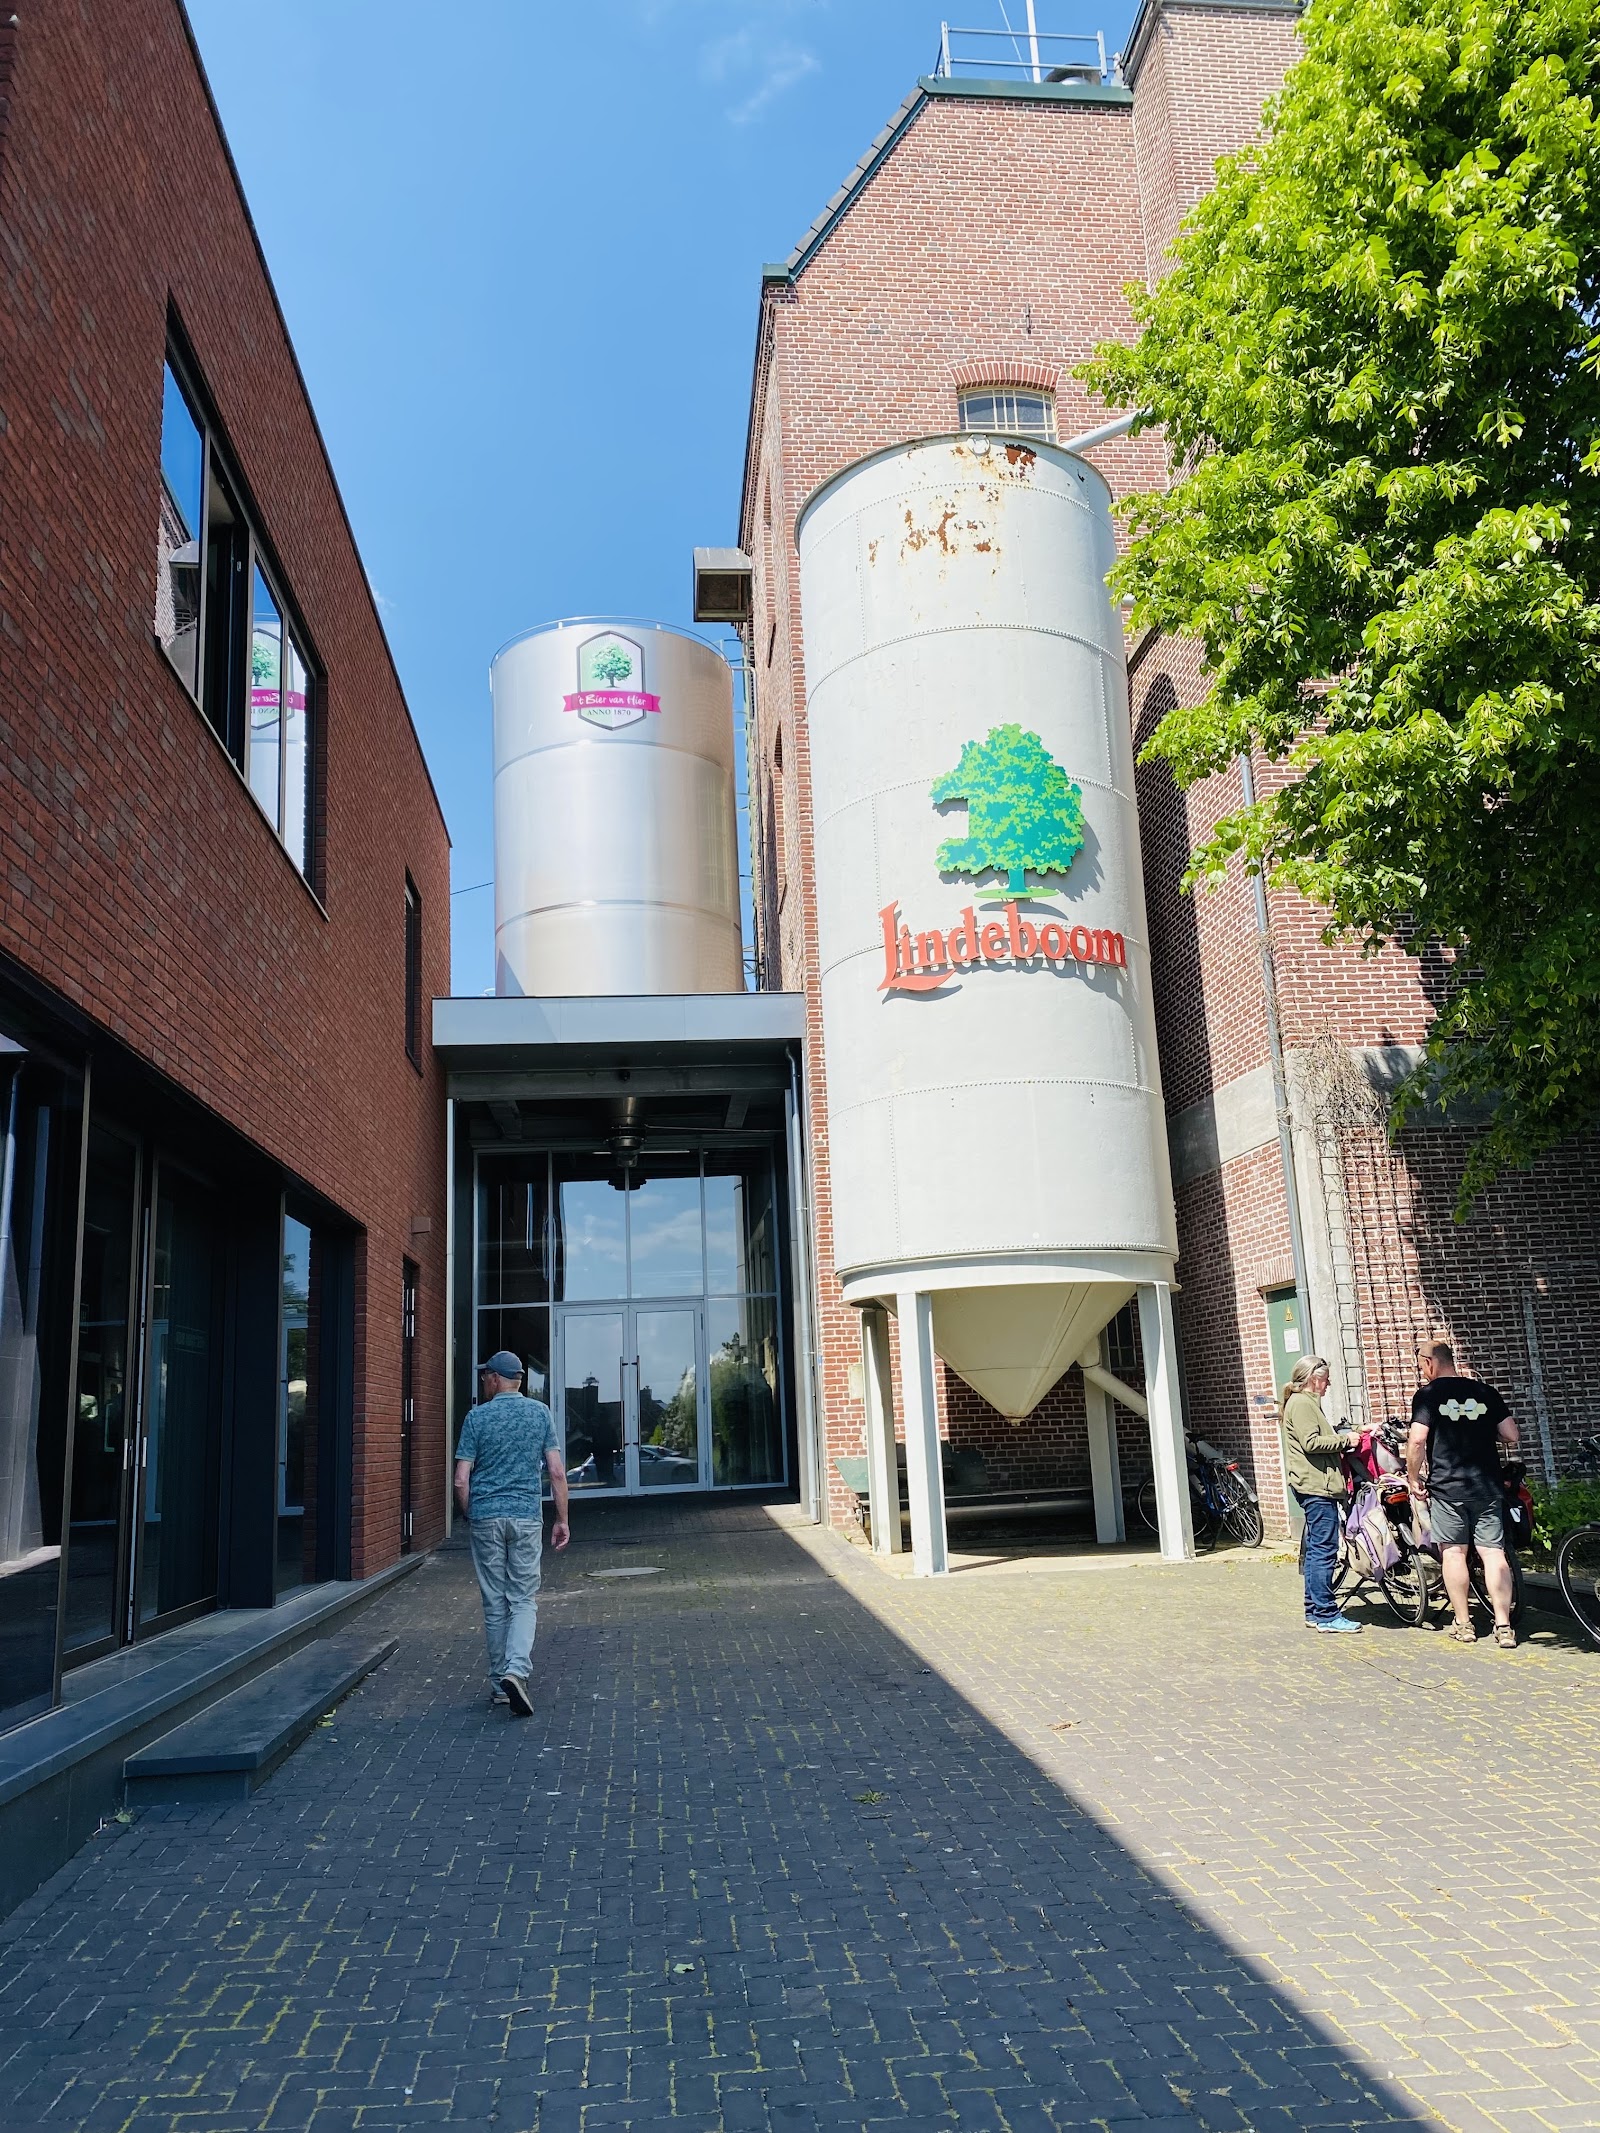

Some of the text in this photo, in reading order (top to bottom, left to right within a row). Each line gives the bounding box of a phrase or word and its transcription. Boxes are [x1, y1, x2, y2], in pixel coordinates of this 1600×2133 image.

[585, 693, 607, 705] Bier
[608, 696, 625, 704] van
[626, 694, 647, 706] Hier
[587, 708, 611, 716] ANNO
[877, 899, 1128, 992] Lindeboom
